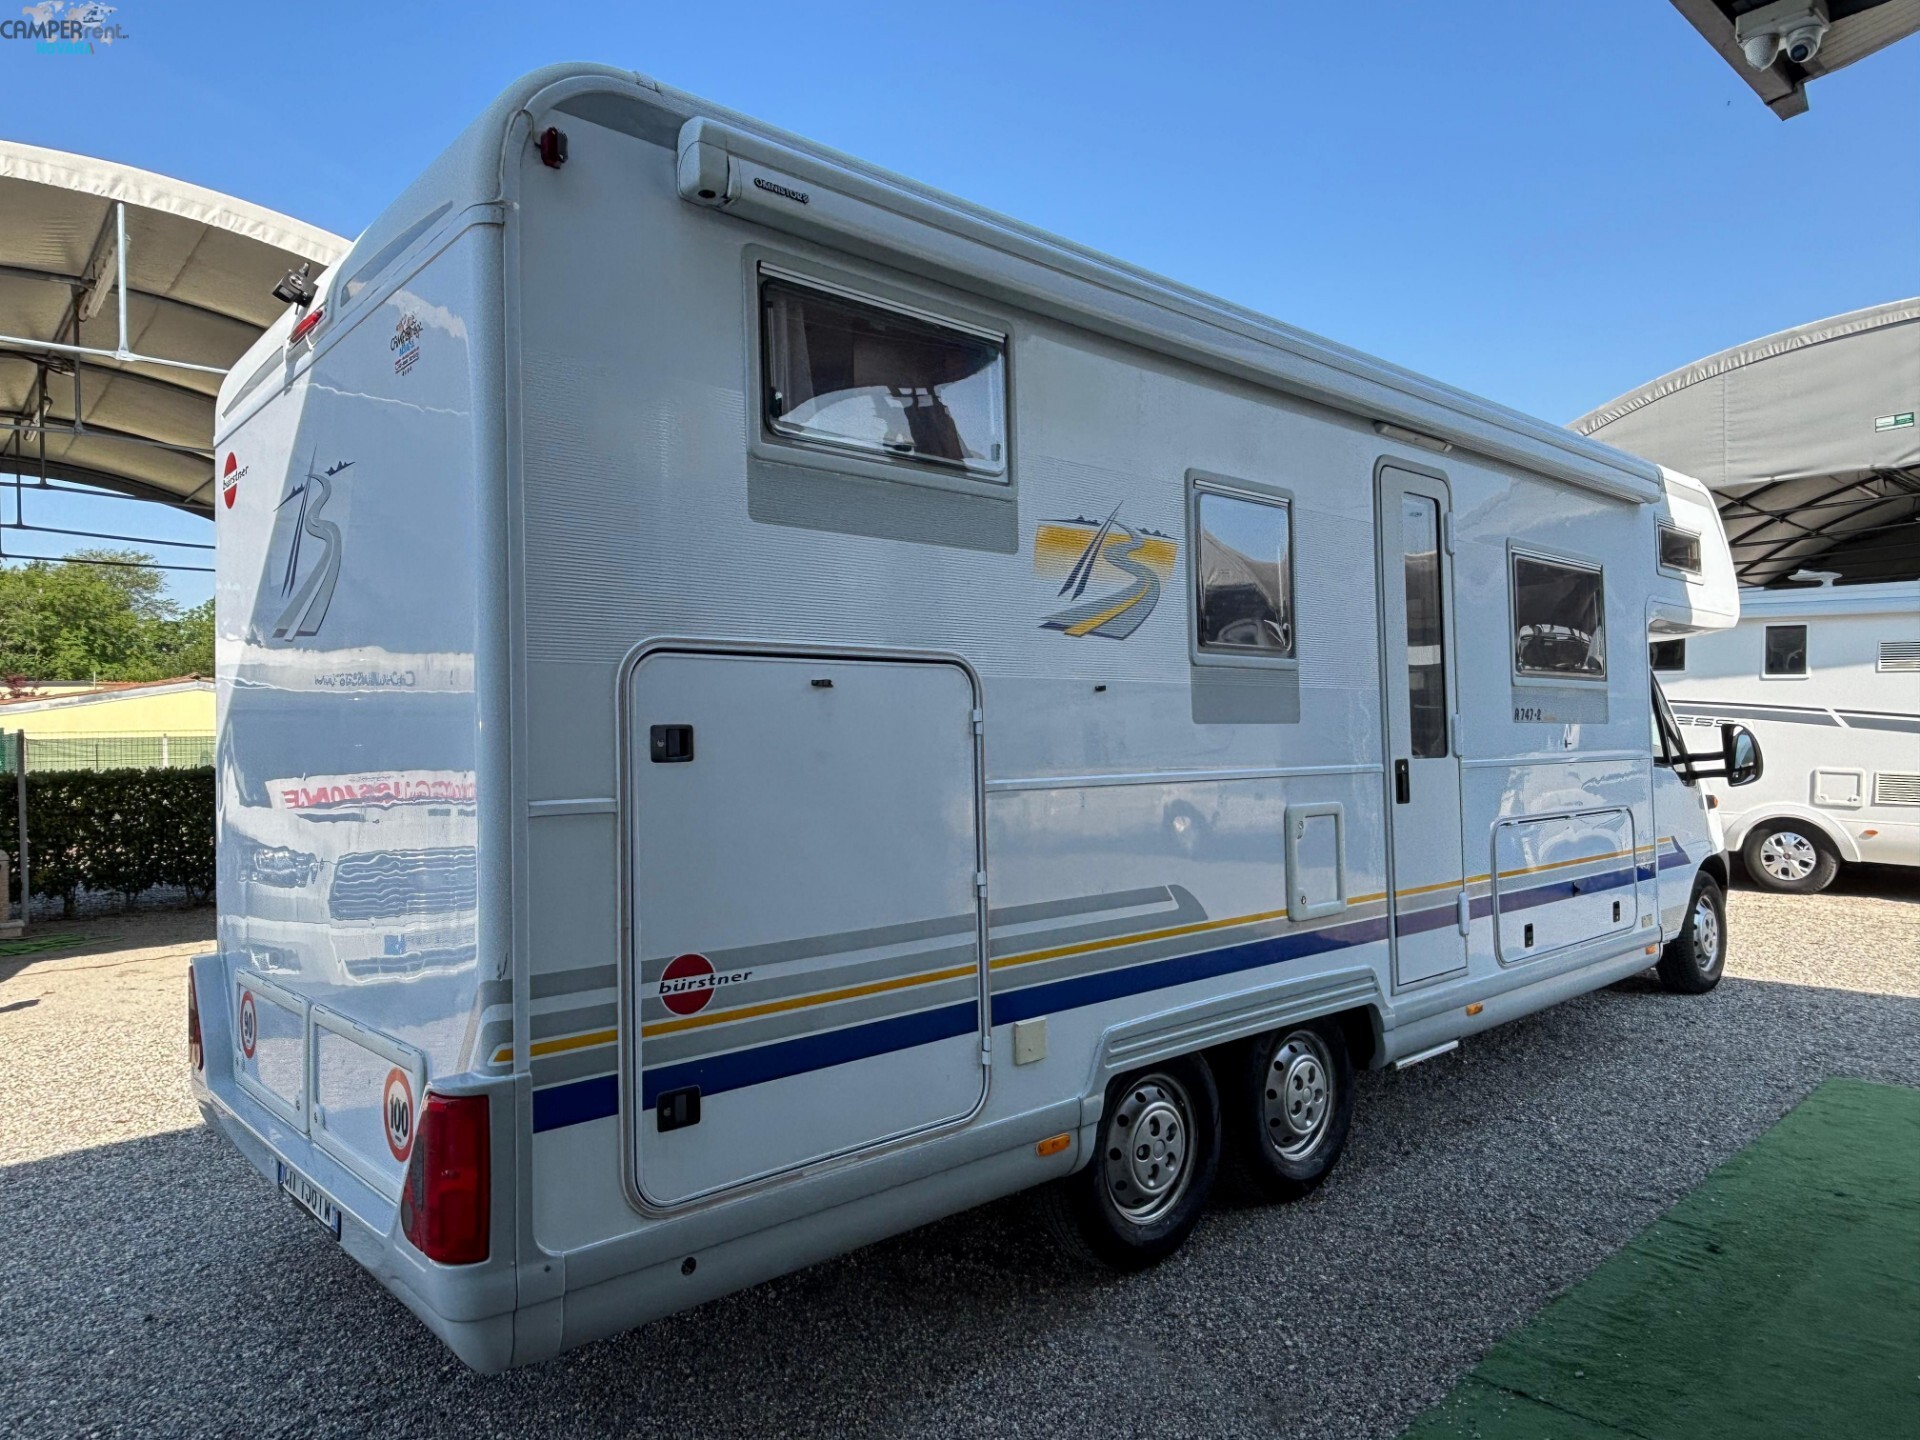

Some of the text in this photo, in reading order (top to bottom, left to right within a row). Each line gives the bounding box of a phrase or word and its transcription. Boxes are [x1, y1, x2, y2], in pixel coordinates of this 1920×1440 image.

[658, 971, 753, 995] bürstner
[244, 1010, 253, 1039] 90
[390, 1094, 409, 1138] 100
